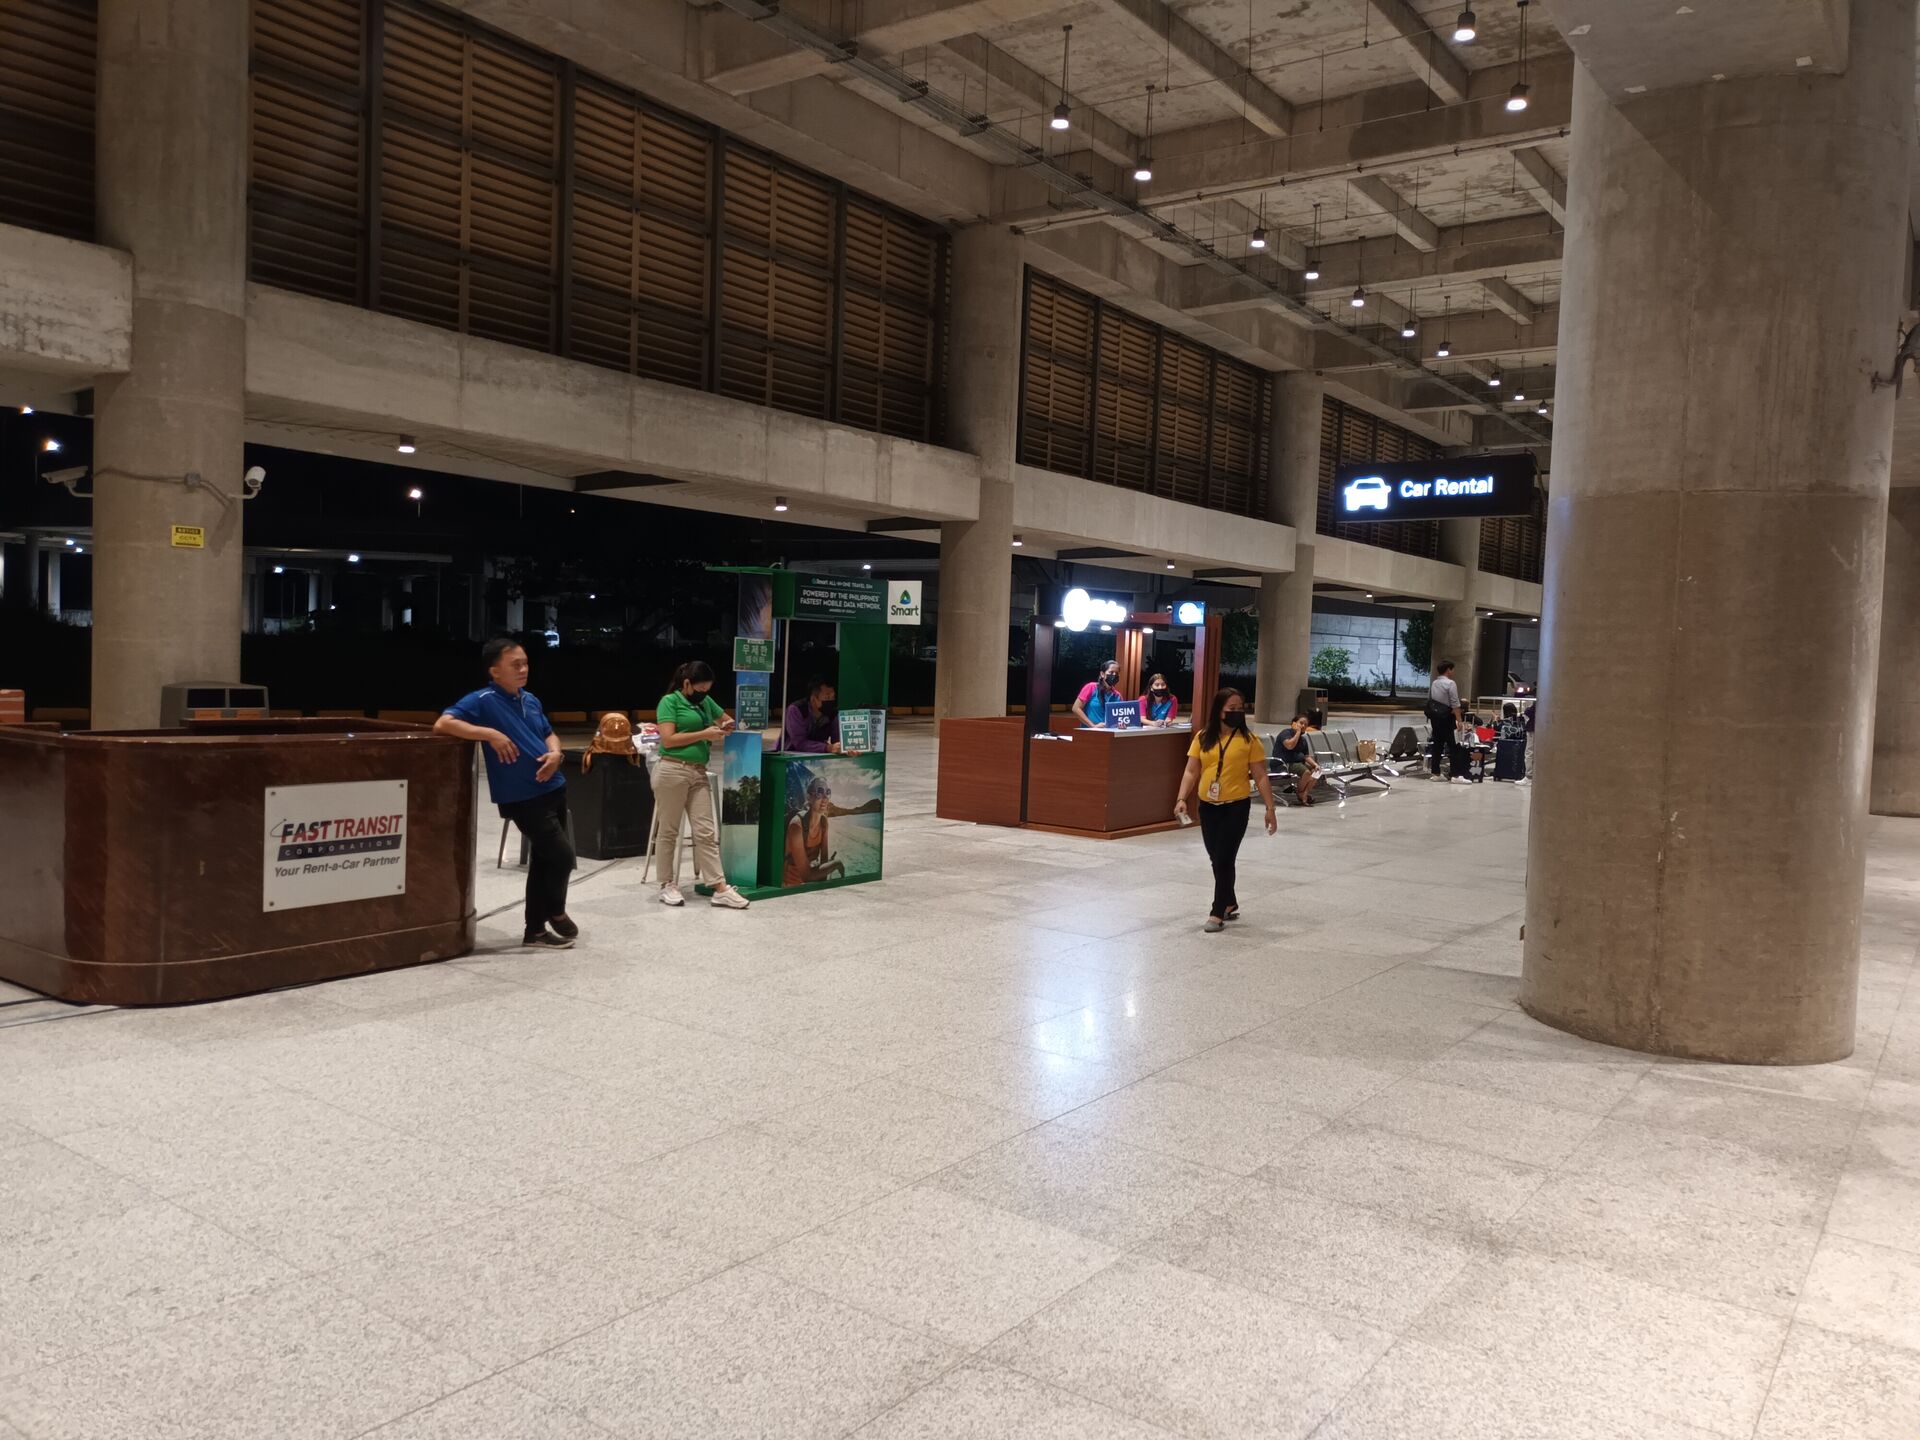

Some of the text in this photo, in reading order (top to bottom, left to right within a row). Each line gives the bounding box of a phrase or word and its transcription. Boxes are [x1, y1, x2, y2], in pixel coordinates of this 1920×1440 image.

[1400, 476, 1494, 497] Car Rental
[803, 589, 829, 598] POWERED
[838, 592, 848, 600] THE
[800, 598, 822, 606] FASTEST
[823, 599, 842, 607] MOBILE
[843, 600, 856, 608] DATA
[890, 604, 919, 616] Smart
[1112, 707, 1135, 717] USIM
[1117, 716, 1131, 725] 5G
[280, 814, 403, 843] FAST TRANSIT
[284, 840, 393, 857] CORPORATION
[274, 855, 401, 878] Your Rent-a-Car Partner
